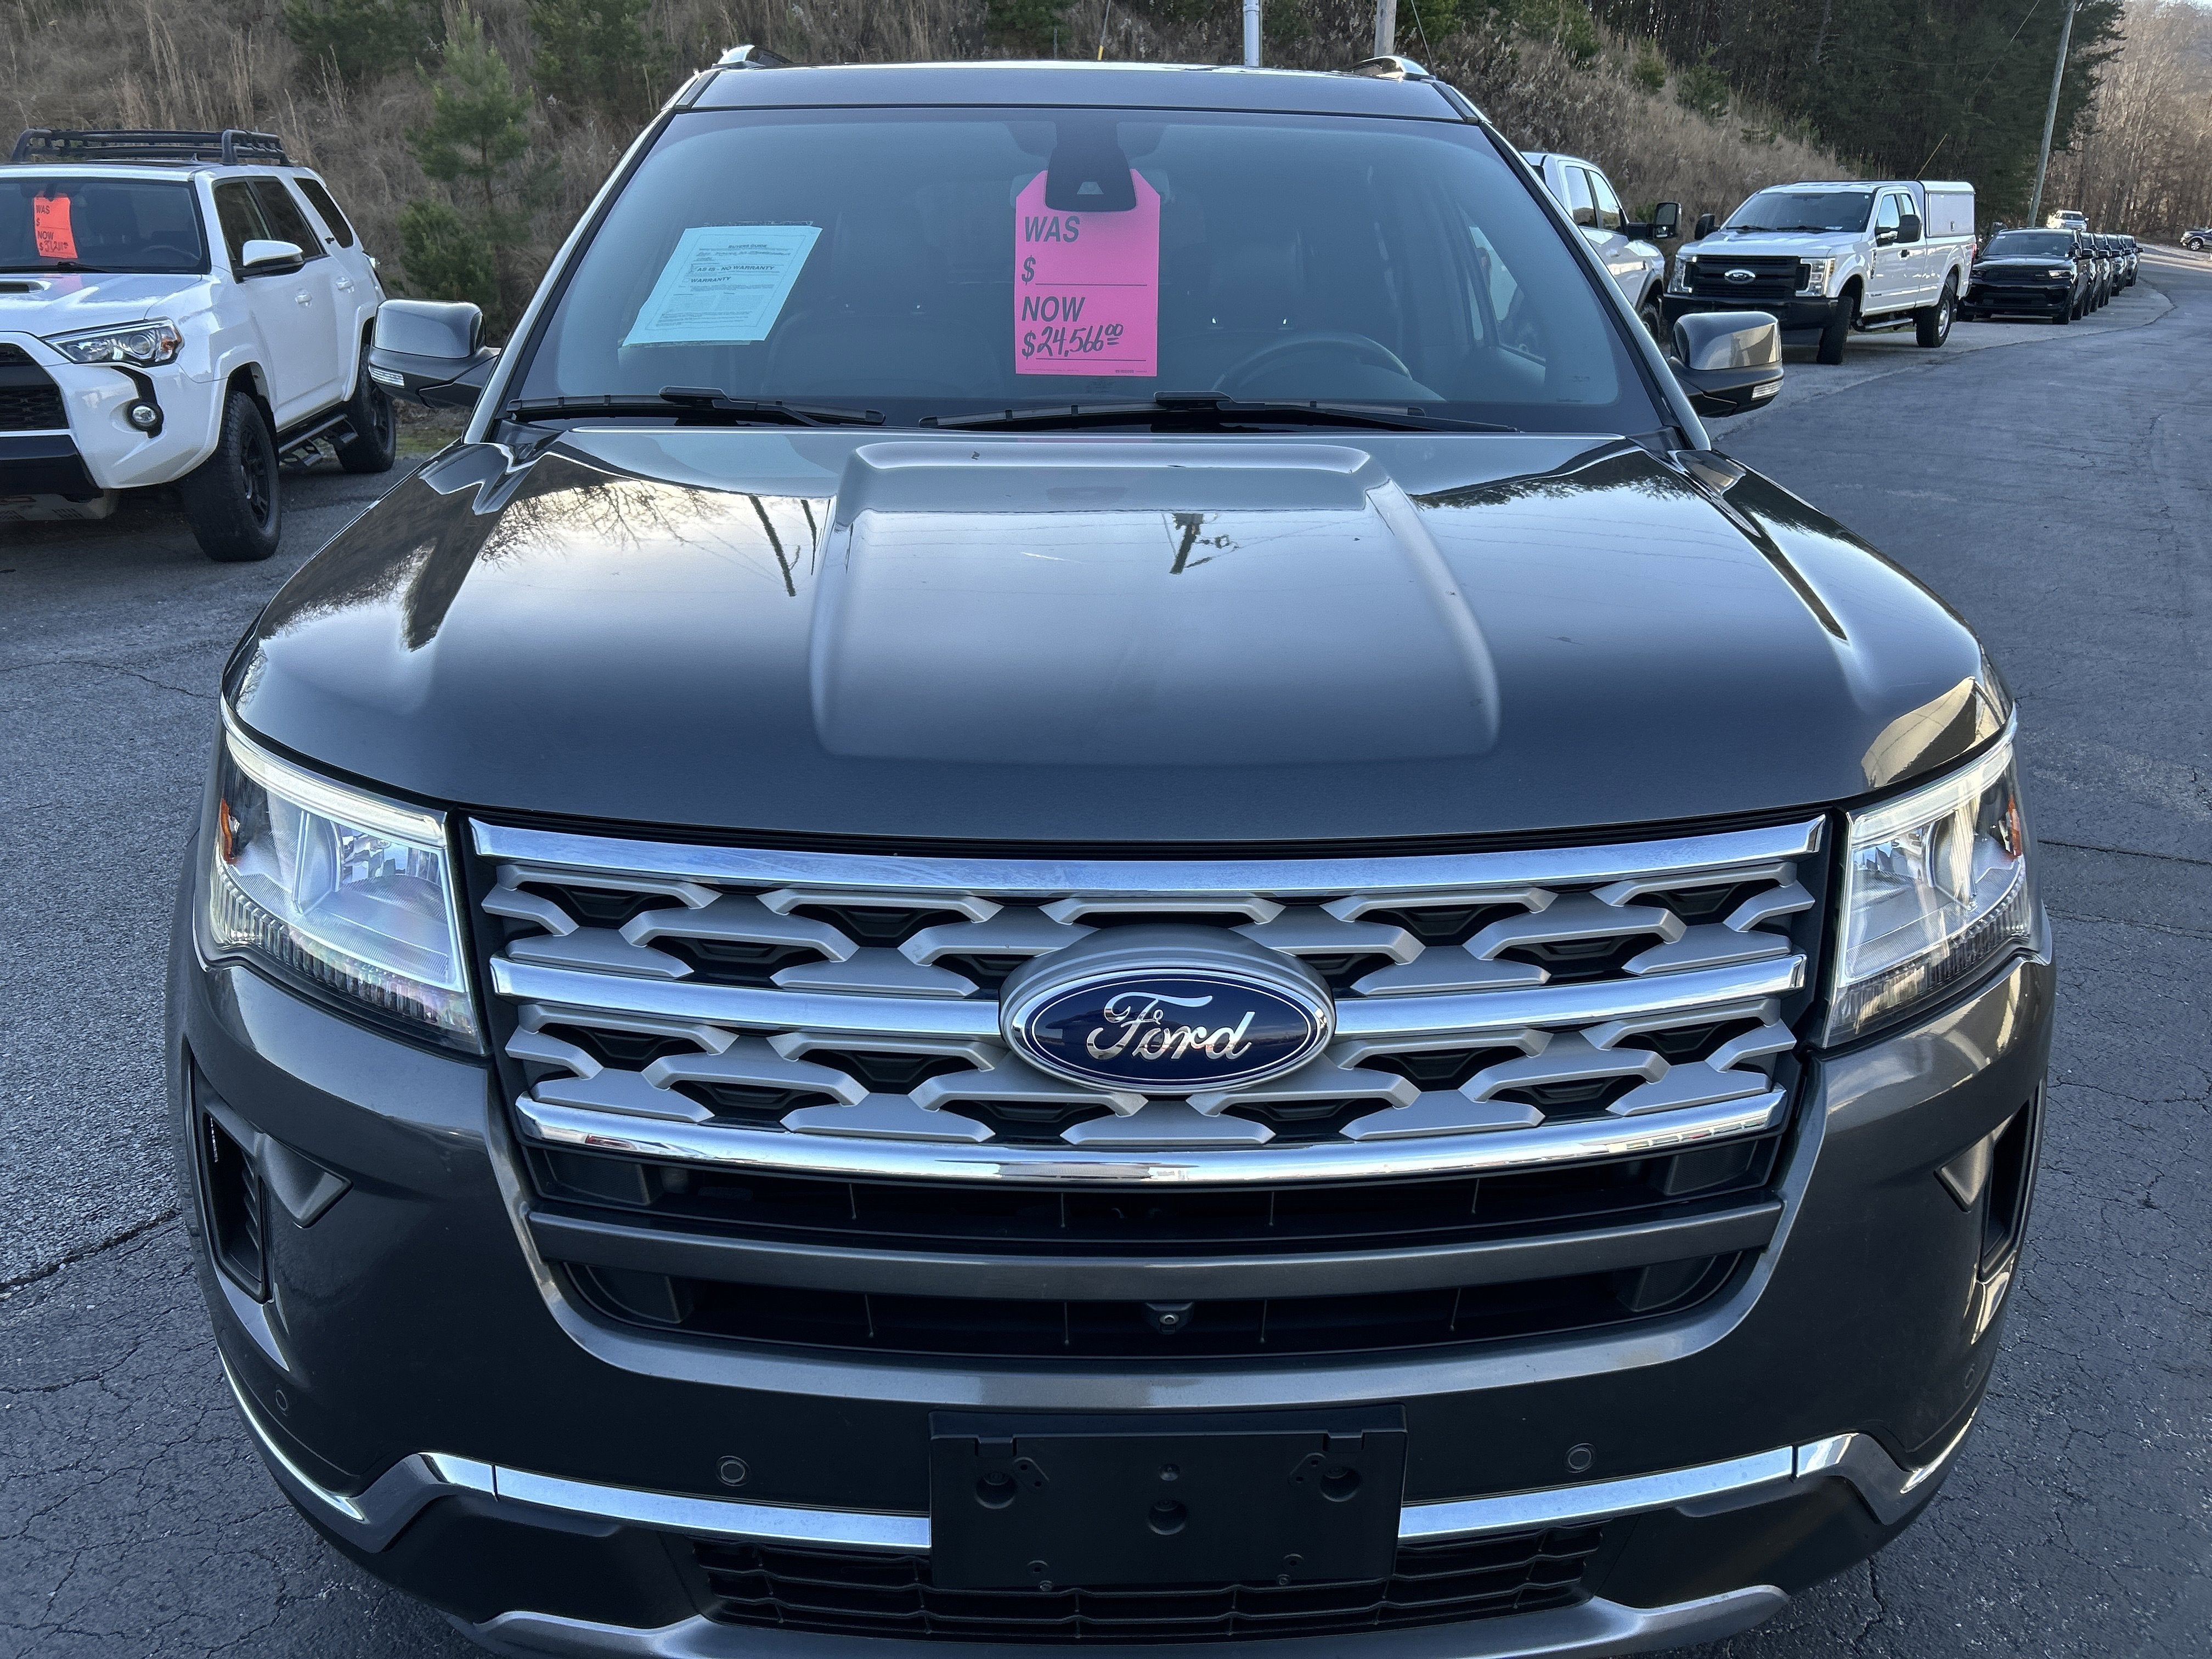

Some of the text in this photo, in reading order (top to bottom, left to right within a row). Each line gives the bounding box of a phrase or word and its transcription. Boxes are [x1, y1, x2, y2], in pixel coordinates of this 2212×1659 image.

[36, 205, 50, 215] WAS
[37, 231, 54, 240] NOW
[1025, 216, 1080, 243] WAS
[1021, 255, 1036, 285] $
[1022, 296, 1086, 322] NOW
[1087, 991, 1255, 1060] Ford
